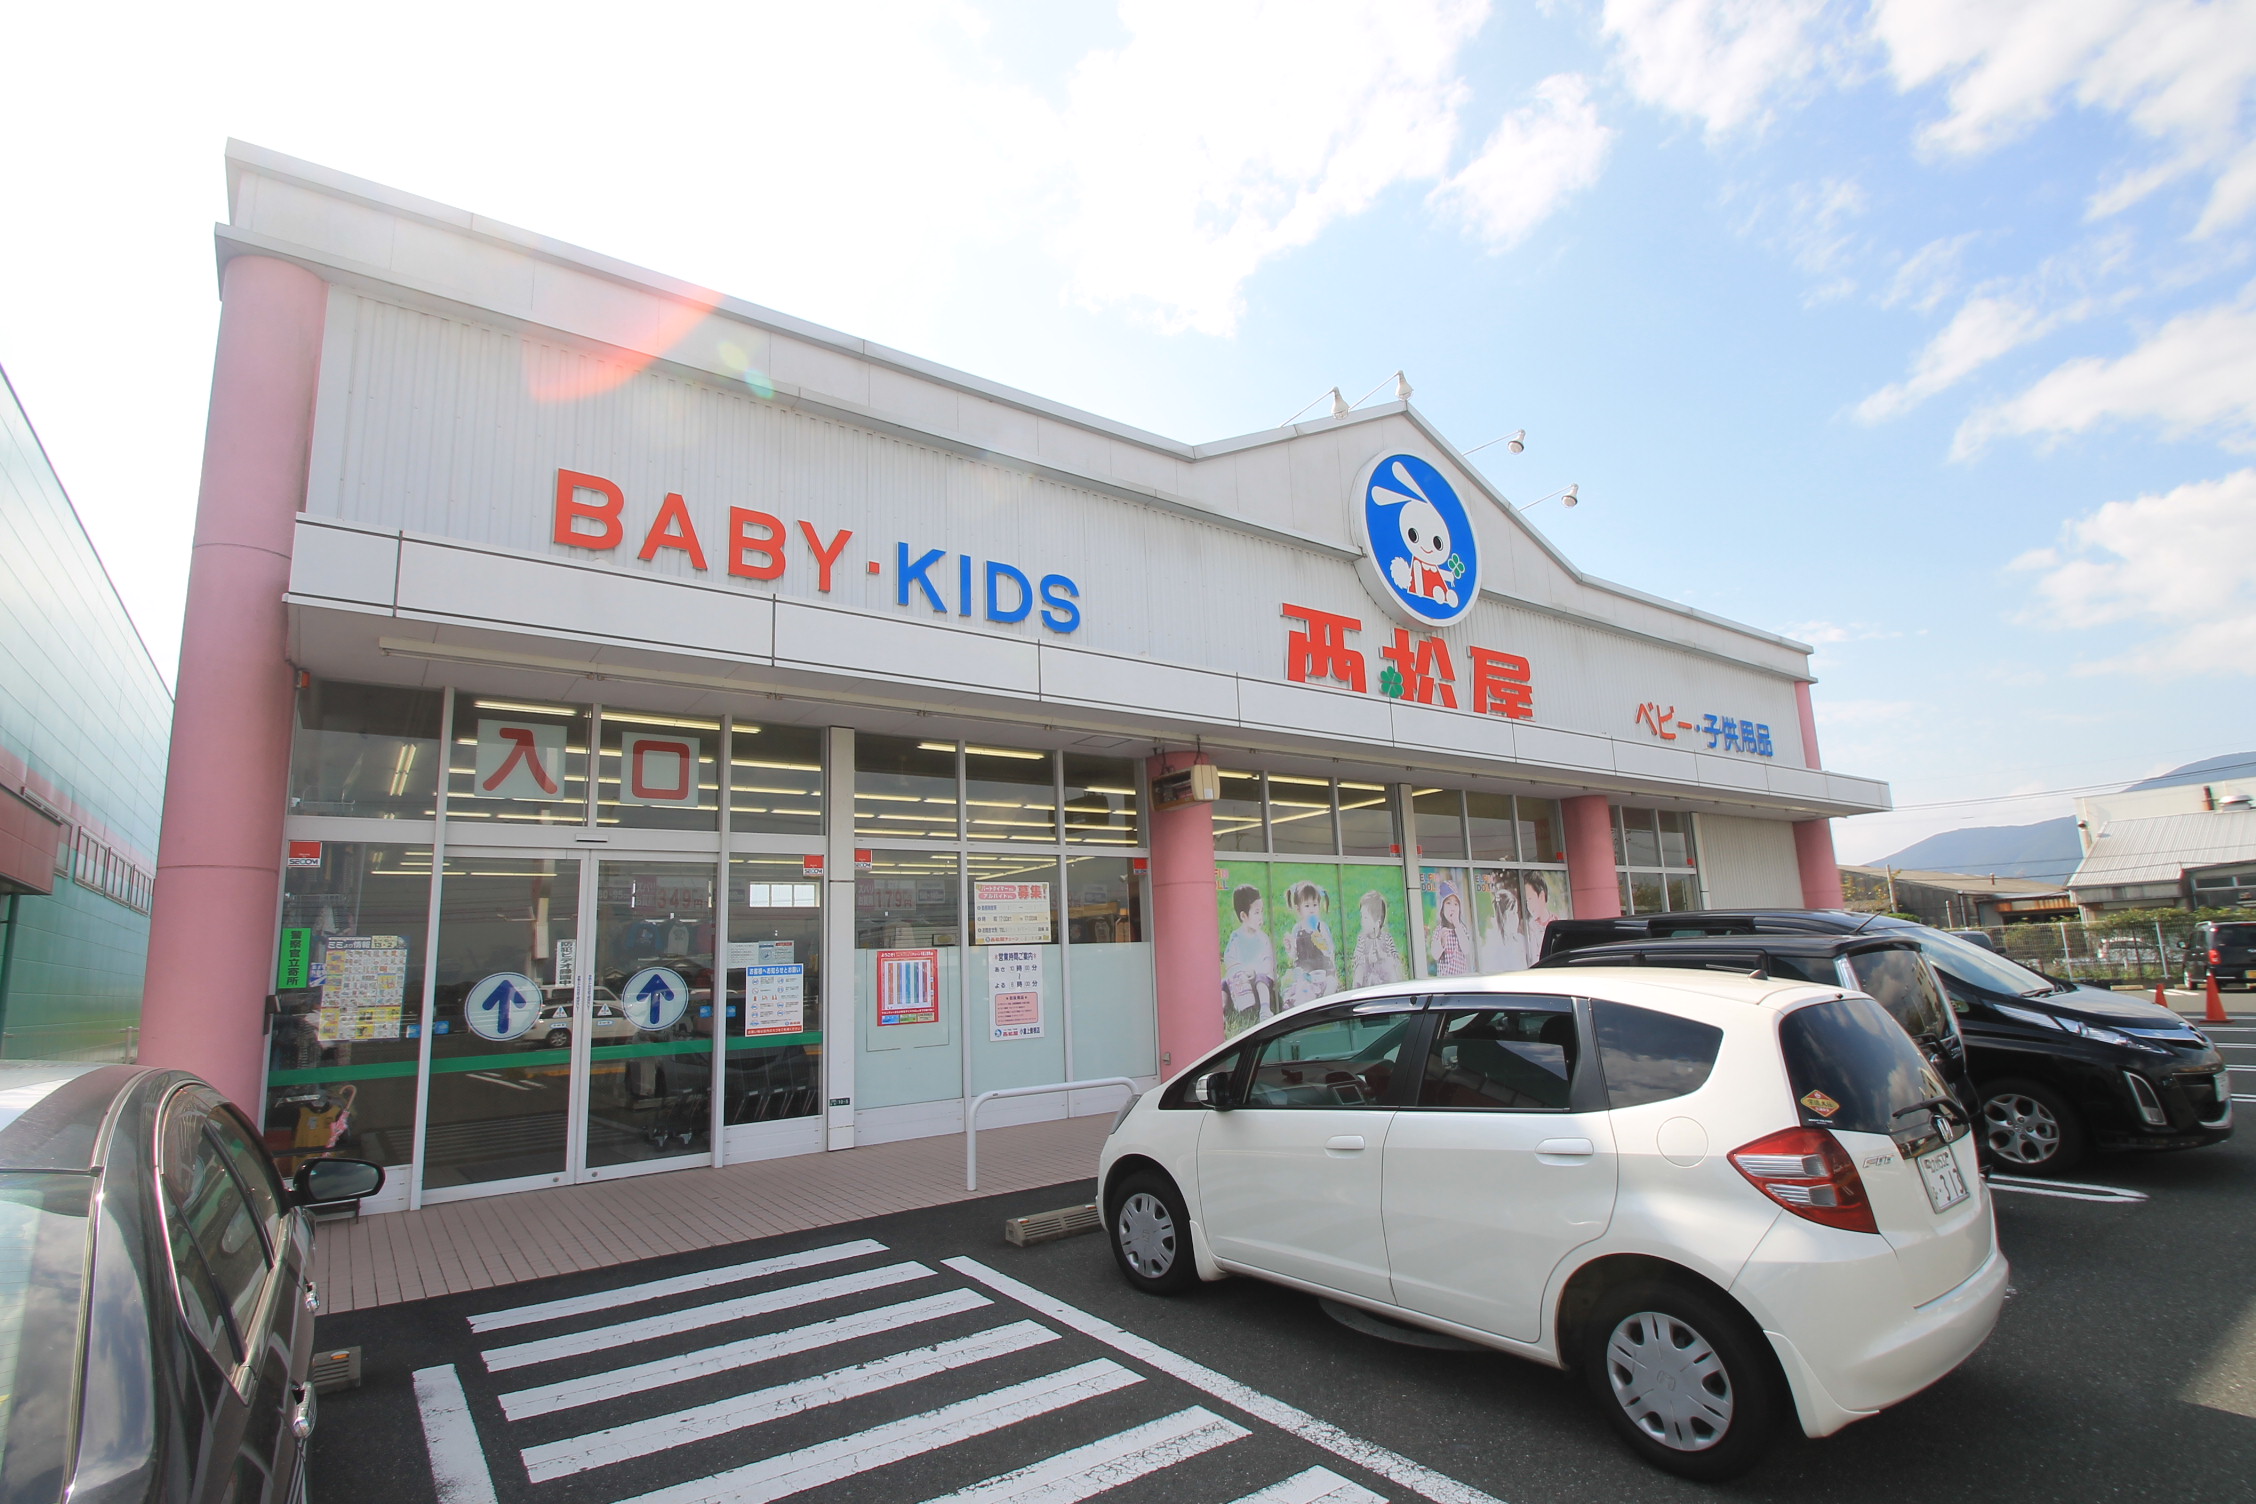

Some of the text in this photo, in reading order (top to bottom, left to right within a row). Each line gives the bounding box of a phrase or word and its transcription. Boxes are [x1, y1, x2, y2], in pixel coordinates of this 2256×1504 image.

[1280, 602, 1536, 722] 西松屋
[483, 727, 690, 801] 入口
[287, 930, 303, 986] 警察官立寄所
[998, 952, 1034, 962] 営業時間ご案内
